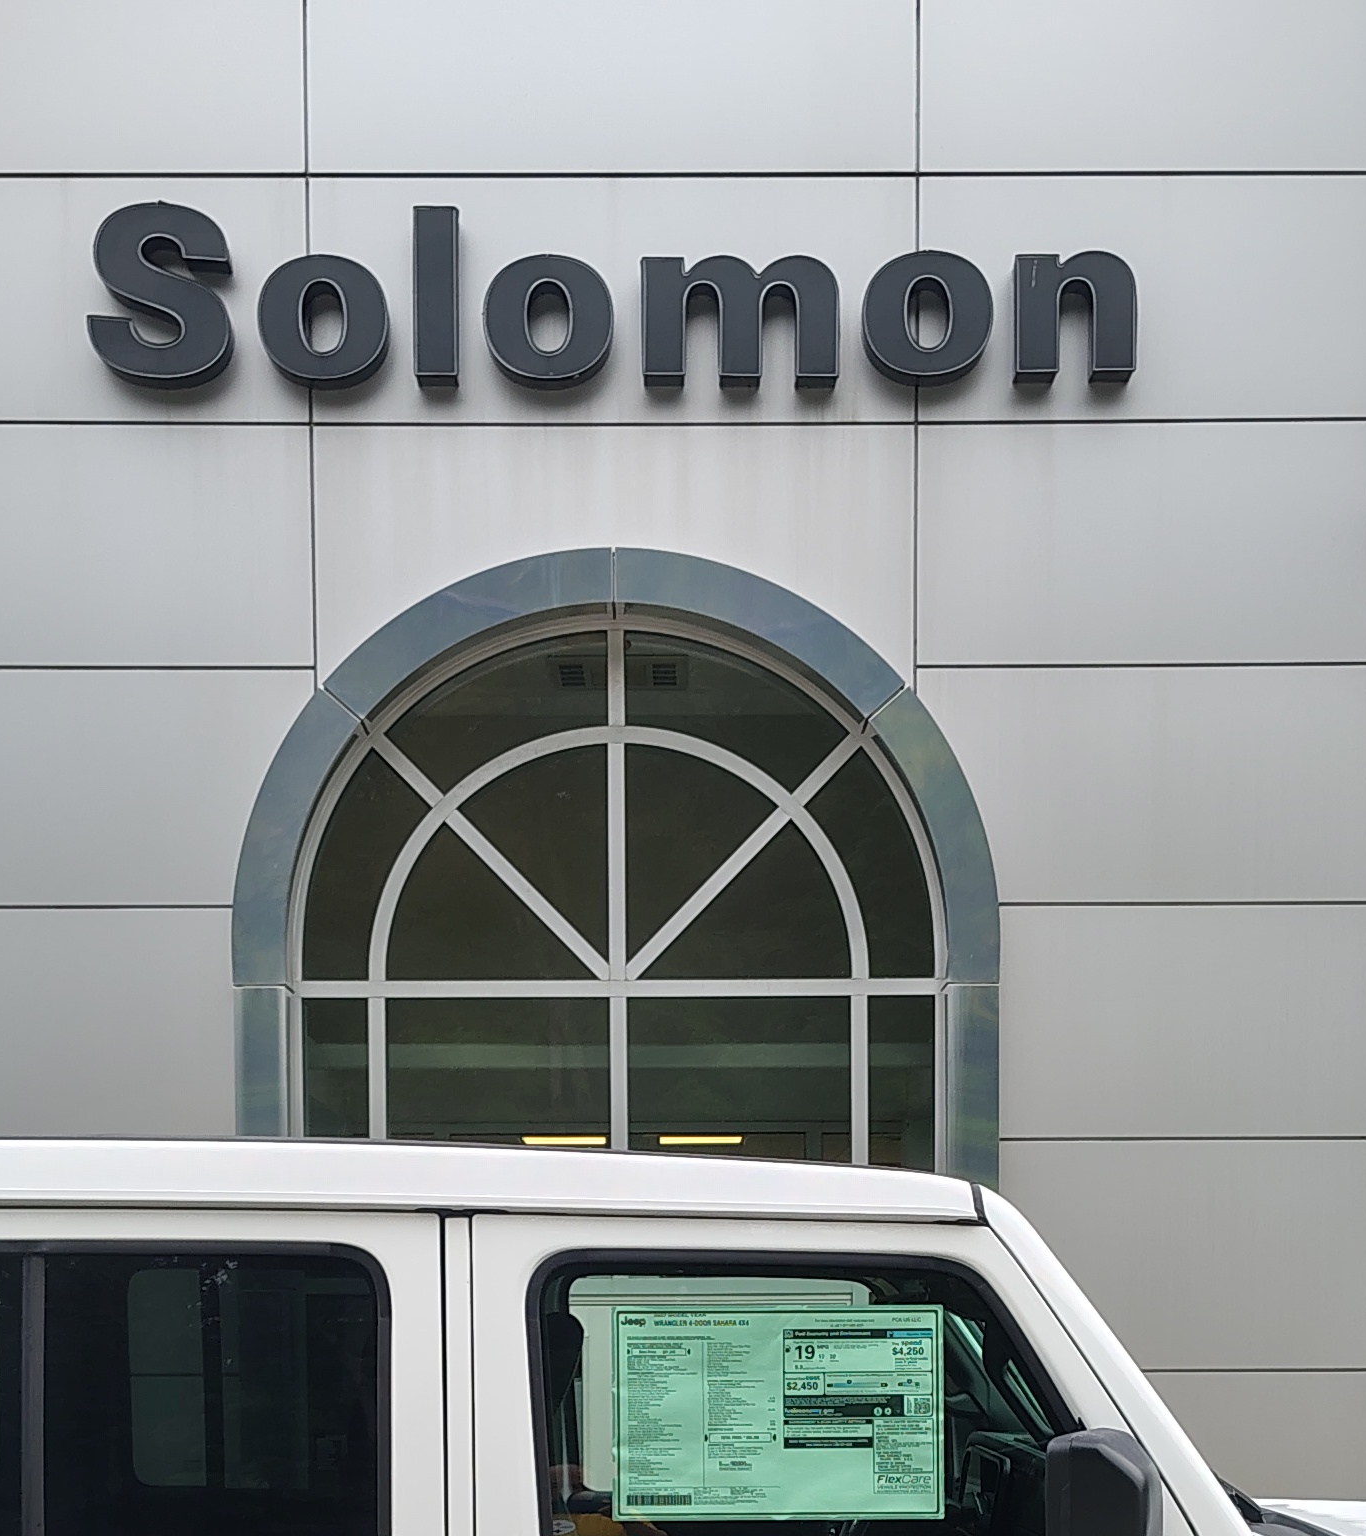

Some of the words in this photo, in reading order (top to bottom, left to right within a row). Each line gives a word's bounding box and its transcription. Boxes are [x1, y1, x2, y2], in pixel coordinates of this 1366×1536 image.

[87, 201, 1138, 390] Solomon
[621, 1316, 646, 1327] Jeep
[795, 1345, 815, 1359] 19
[892, 1347, 924, 1356] $4,250
[786, 1382, 818, 1391] $2,450
[877, 1474, 931, 1484] FlexCare
